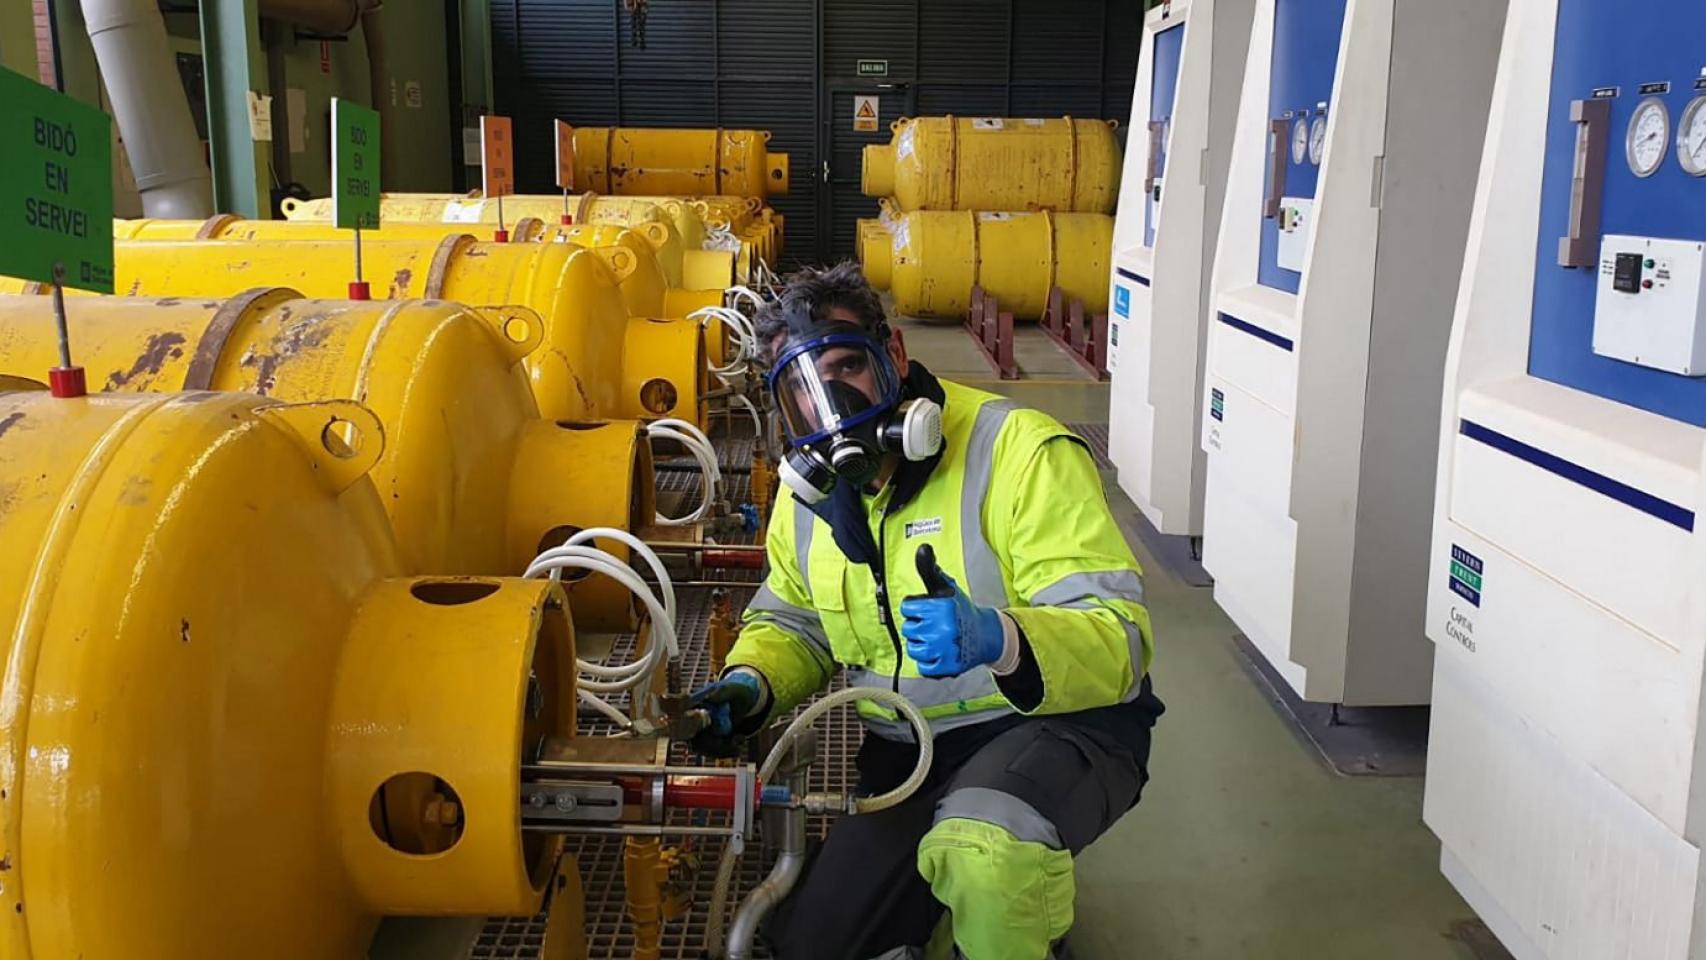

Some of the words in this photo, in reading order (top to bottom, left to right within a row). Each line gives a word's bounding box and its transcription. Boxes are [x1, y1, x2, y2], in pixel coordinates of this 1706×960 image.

[34, 116, 77, 157] BIDÓ
[45, 161, 68, 194] EN
[26, 197, 88, 239] SERVEI
